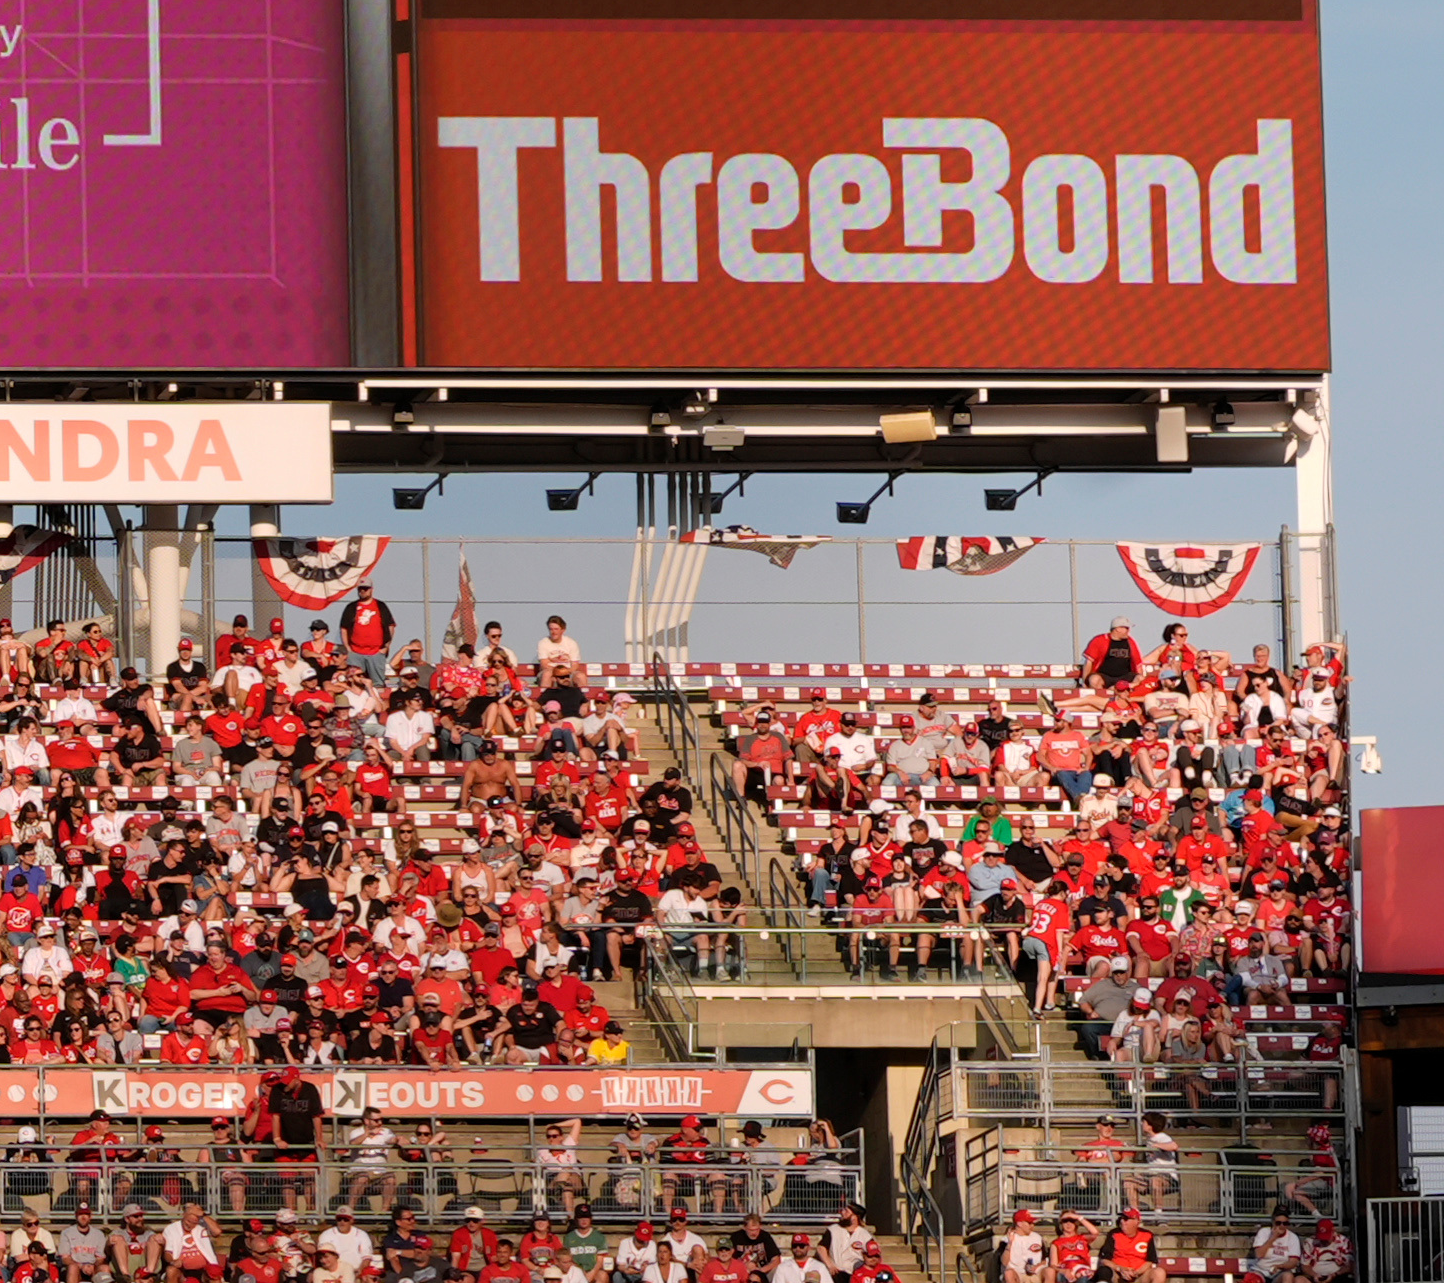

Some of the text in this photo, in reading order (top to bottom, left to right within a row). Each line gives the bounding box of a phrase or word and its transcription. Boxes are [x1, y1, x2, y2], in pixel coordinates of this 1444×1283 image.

[438, 118, 1297, 284] ThreeBond
[1090, 933, 1119, 947] Reds
[93, 1073, 246, 1112] KROGER
[759, 1078, 795, 1104] C
